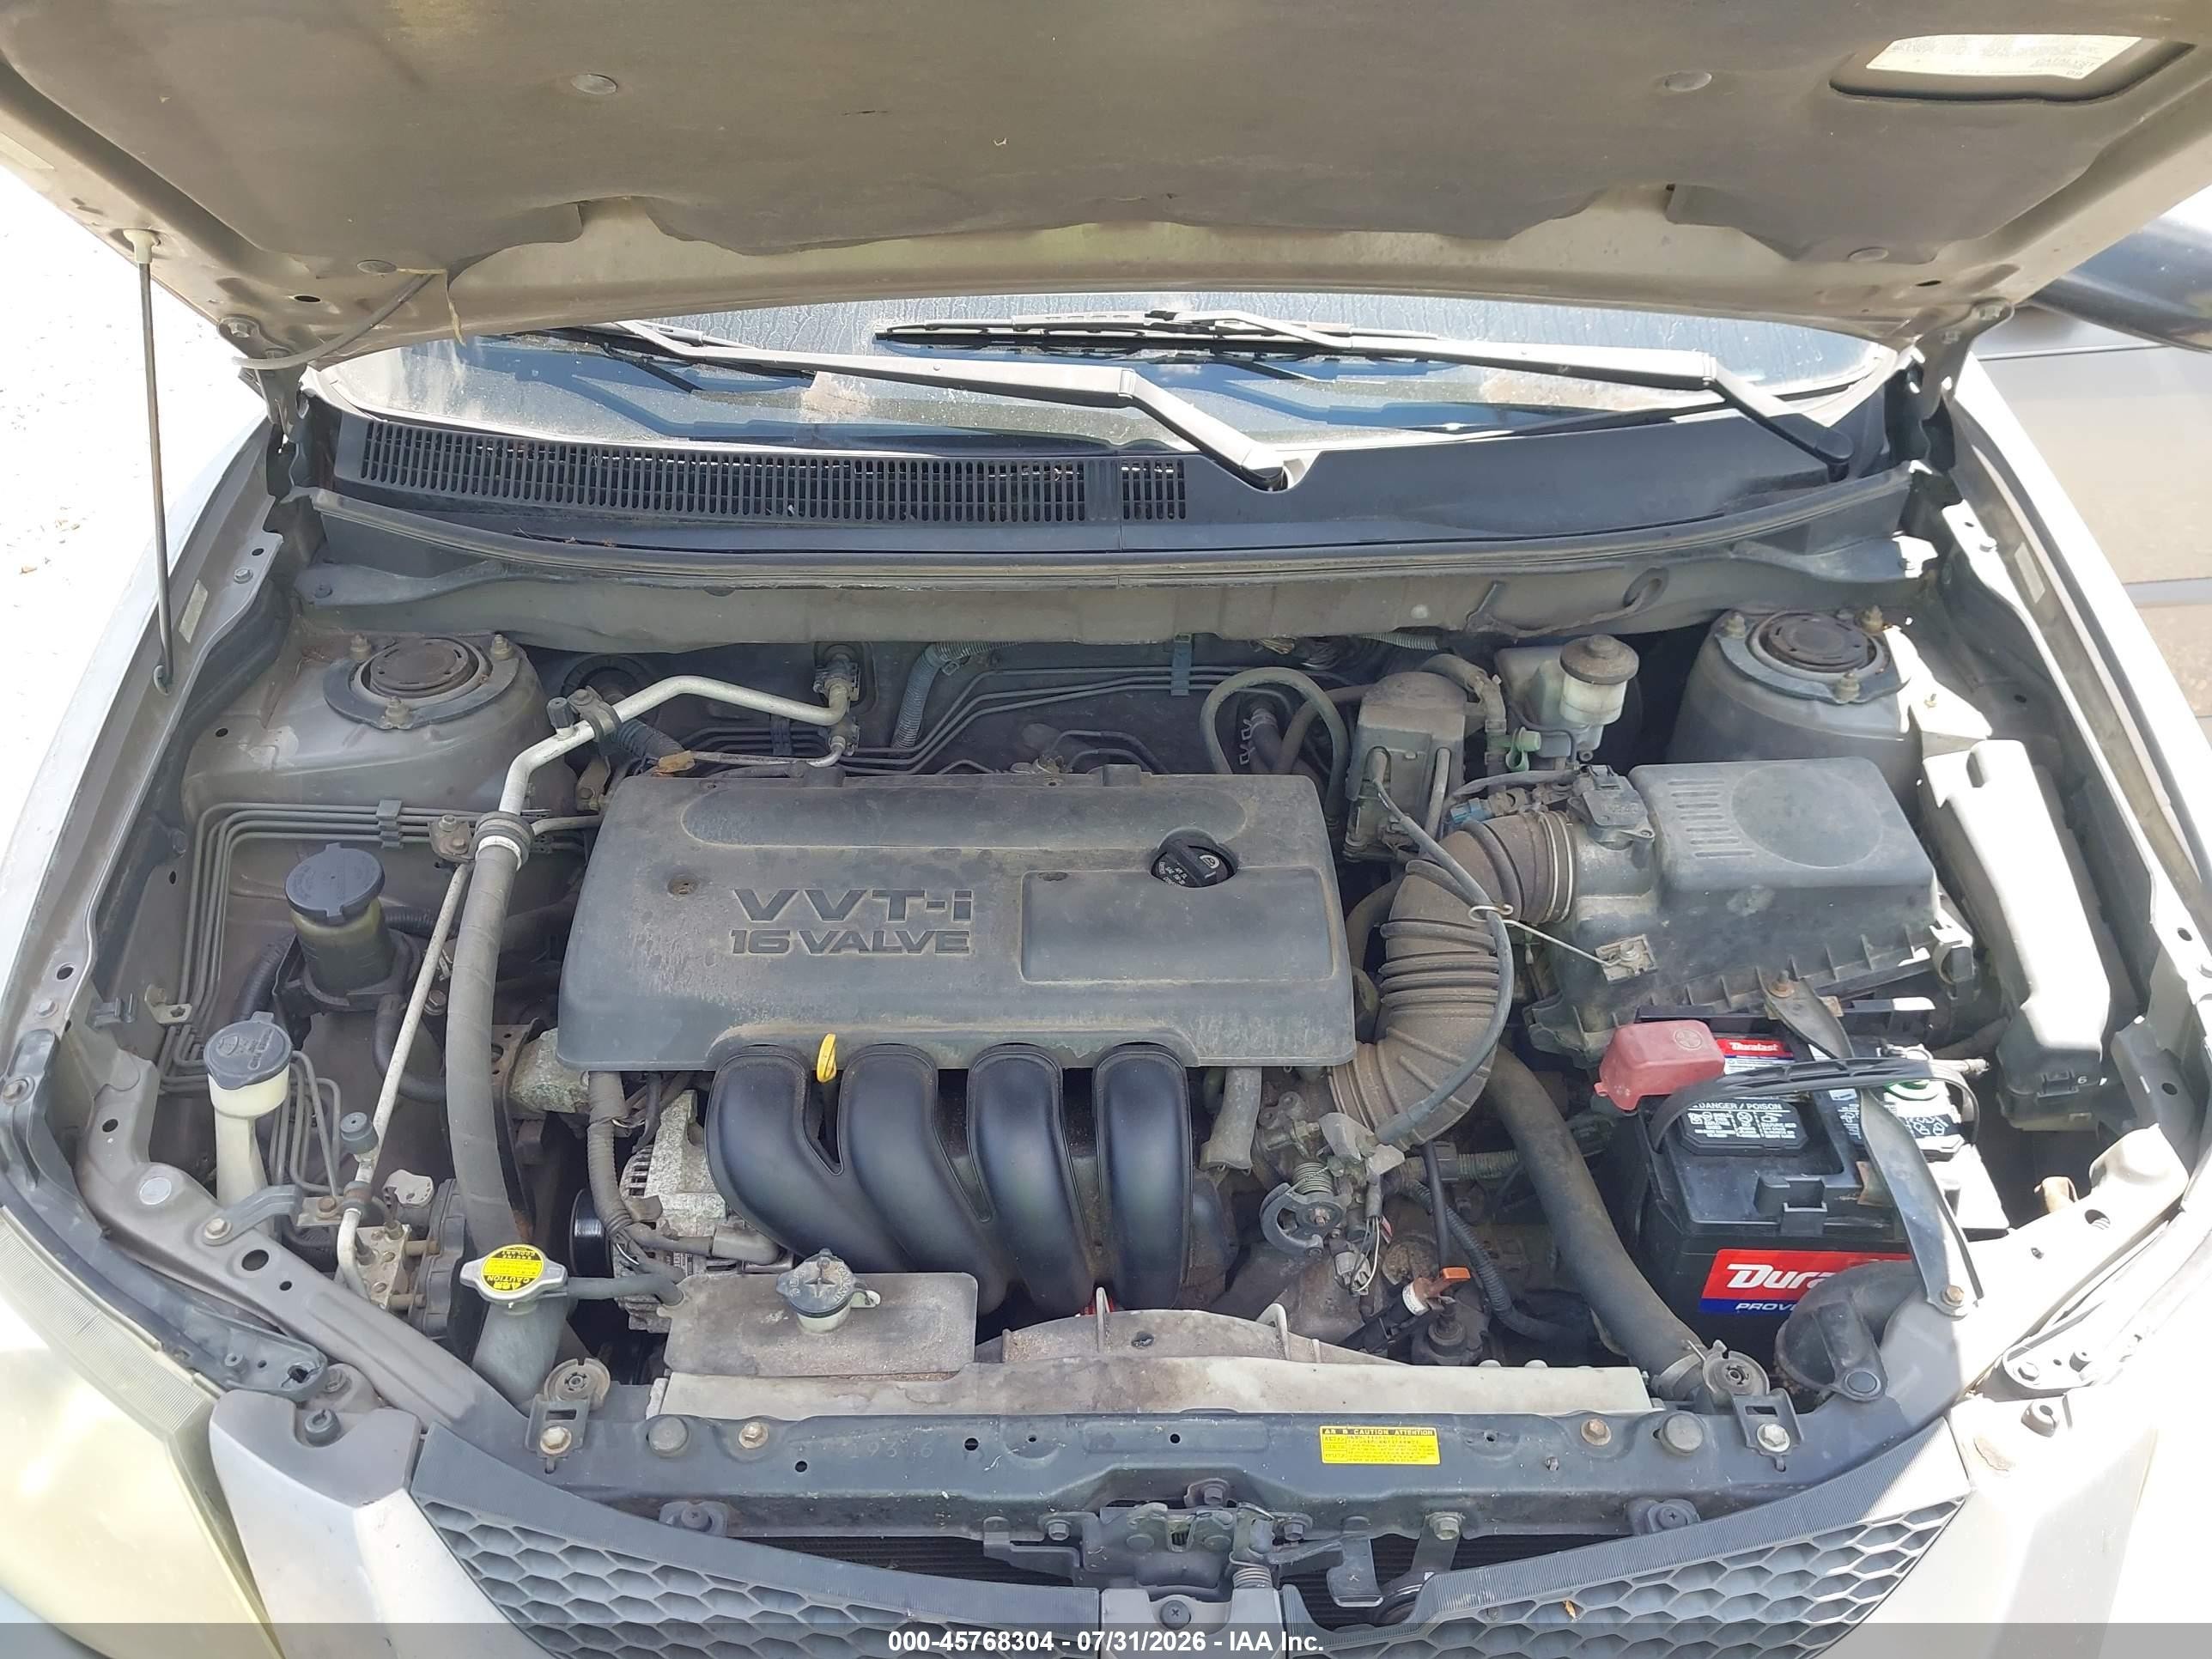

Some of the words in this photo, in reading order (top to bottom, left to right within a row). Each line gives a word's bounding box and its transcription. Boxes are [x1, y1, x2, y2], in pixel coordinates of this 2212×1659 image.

[732, 889, 974, 922] VVT-i
[731, 929, 791, 955] 16
[797, 929, 970, 955] VALVE
[487, 1275, 530, 1284] CAUTION
[1735, 1303, 1796, 1311] PROV
